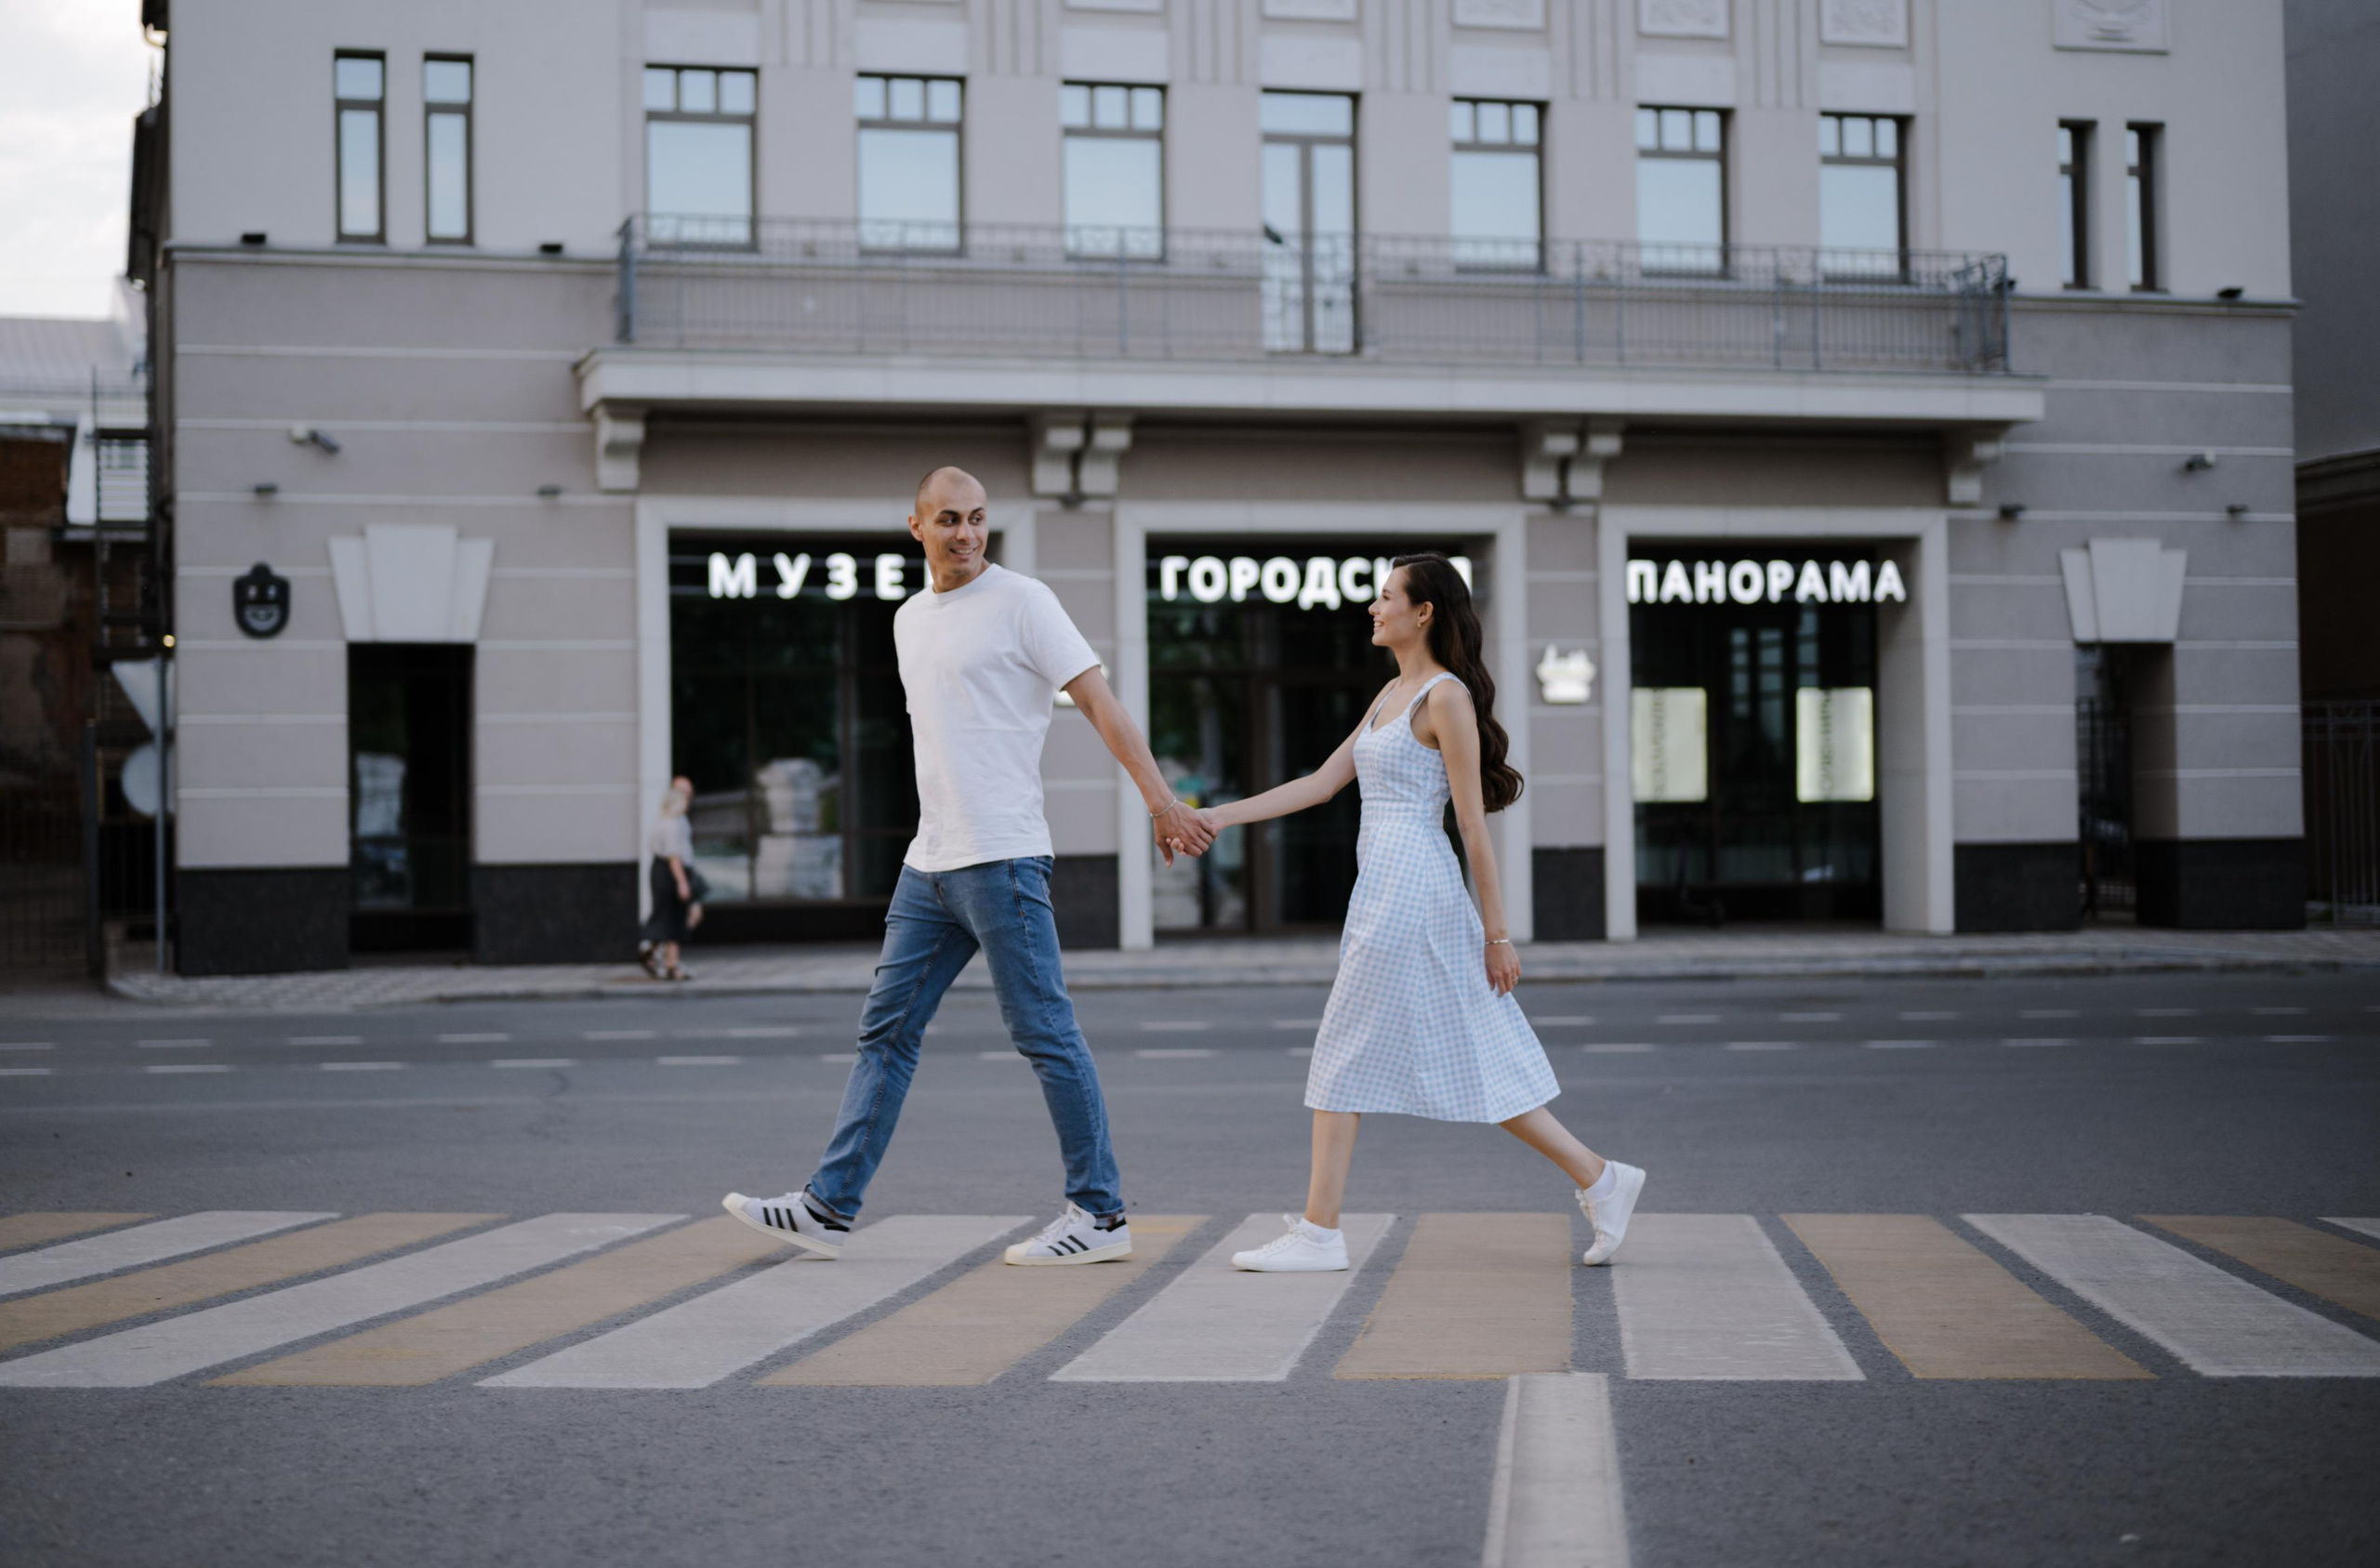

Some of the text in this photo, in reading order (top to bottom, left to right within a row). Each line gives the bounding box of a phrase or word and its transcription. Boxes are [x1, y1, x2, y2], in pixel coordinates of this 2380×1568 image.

[707, 551, 1906, 610] МУЗЕ ГОРОДС ПАНОРАМА
